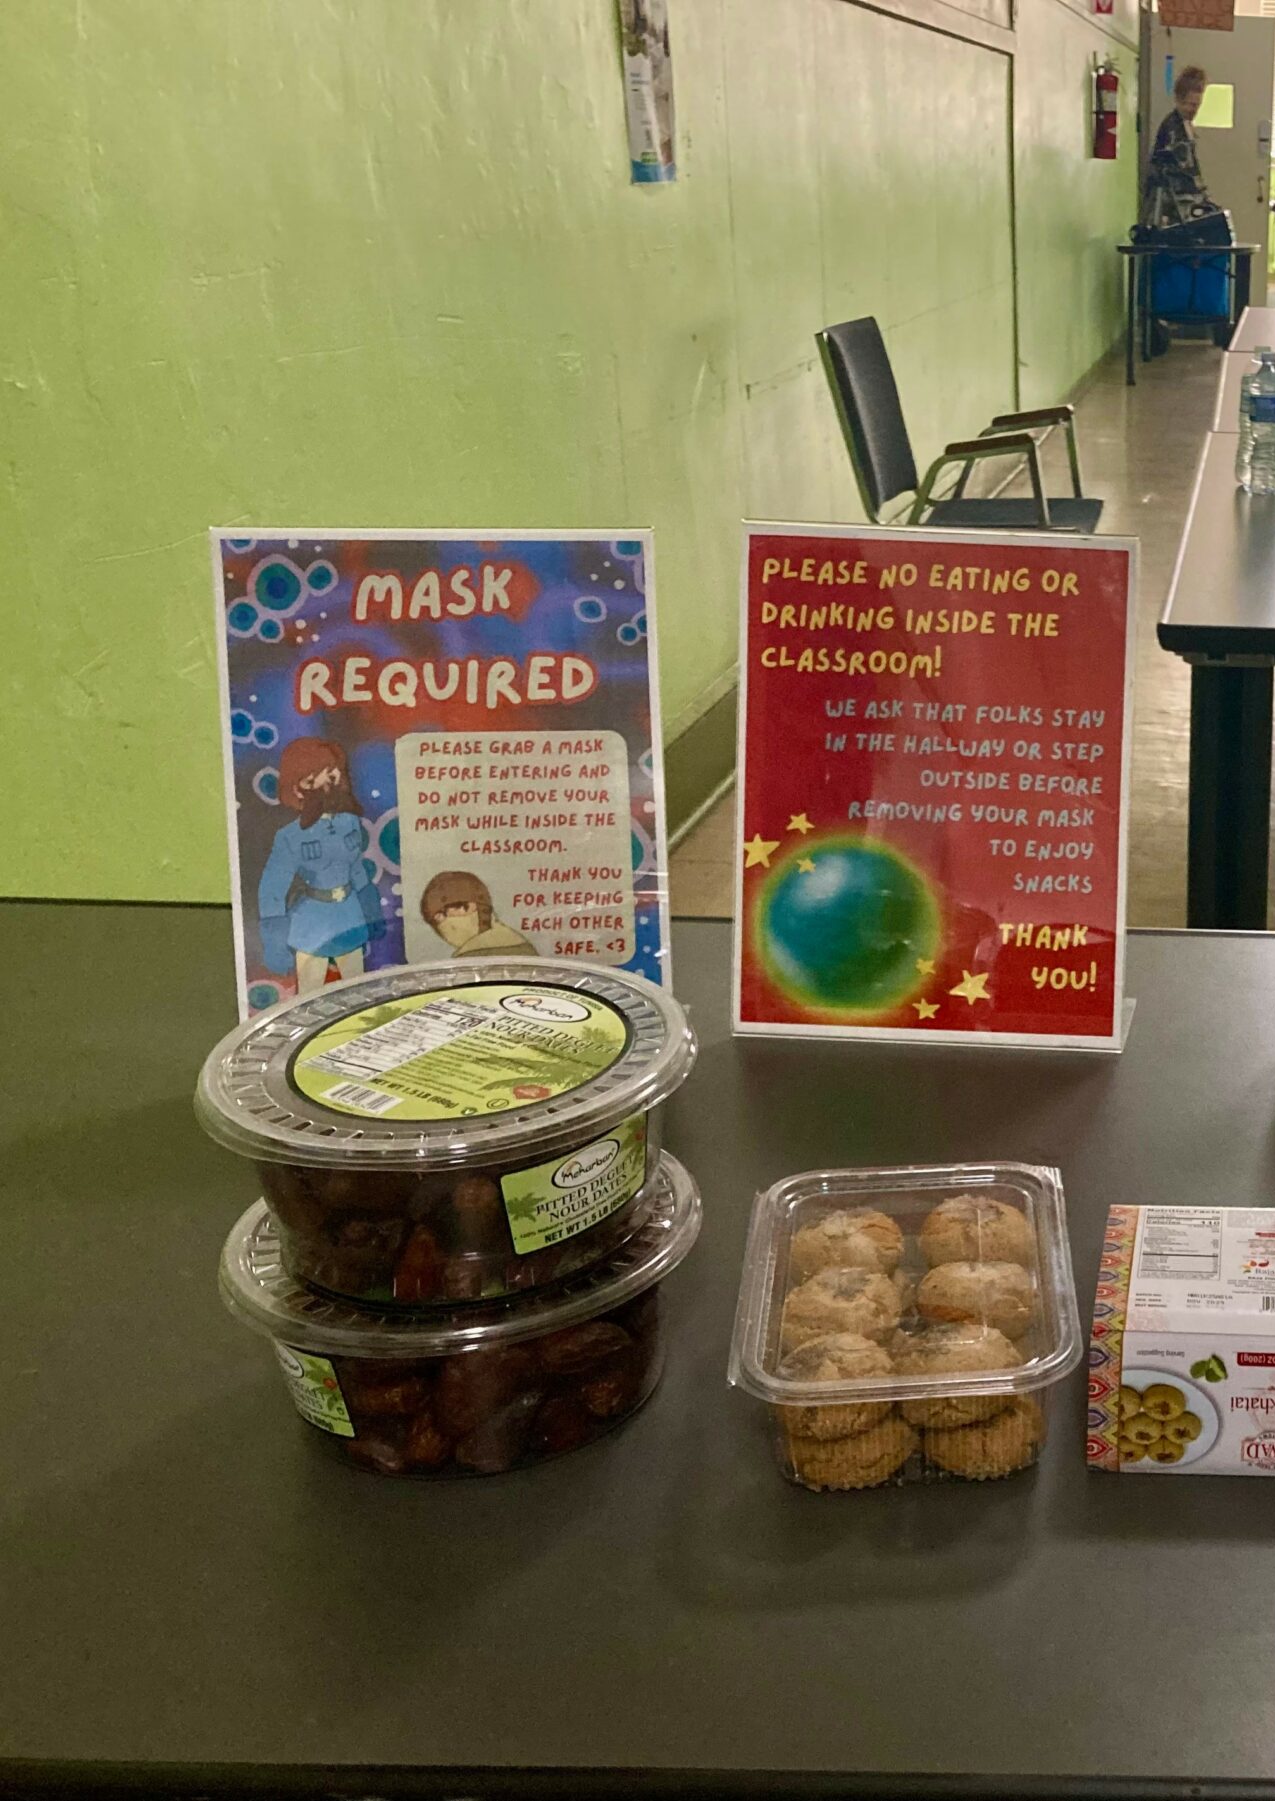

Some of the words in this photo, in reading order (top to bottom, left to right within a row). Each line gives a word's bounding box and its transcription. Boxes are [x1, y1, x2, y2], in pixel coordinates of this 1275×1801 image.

[762, 557, 868, 585] PLEASE
[880, 562, 918, 590] NO
[929, 564, 1031, 595] EATING
[1042, 569, 1079, 597] OR
[356, 566, 513, 621] MASK
[762, 602, 894, 631] DRINKING
[905, 608, 995, 636] INSIDE
[1008, 612, 1060, 637] THE
[761, 646, 942, 678] CLASSROOM!
[300, 656, 594, 711] REQUIRED
[825, 700, 856, 717] WE
[865, 701, 903, 719] ASK
[913, 704, 966, 722] THAT
[976, 706, 1043, 726] FOLKS
[1052, 708, 1105, 728] STAY
[420, 740, 483, 756] PLEASE
[490, 740, 535, 756] GRAB
[542, 741, 553, 755] A
[559, 739, 604, 755] MASK
[825, 732, 845, 751] IN
[856, 733, 894, 752] THE
[903, 735, 1003, 758] HALLWAY
[1014, 742, 1042, 760] OR
[1051, 743, 1103, 760] STEP
[415, 764, 482, 780] BEFORE
[489, 764, 571, 780] ENTERING
[579, 764, 611, 779] AND
[920, 770, 1009, 790] OUTSIDE
[1019, 775, 1103, 795] BEFORE
[418, 790, 440, 805] DO
[449, 790, 480, 805] NOT
[488, 790, 558, 805] REMOVE
[564, 789, 610, 805] YOUR
[415, 815, 459, 832] MASK
[467, 813, 519, 829] WHILE
[525, 812, 578, 828] INSIDE
[584, 811, 616, 827] THE
[848, 802, 962, 823] REMOVING
[971, 807, 1028, 826] YOUR
[1037, 809, 1094, 827] MASK
[460, 839, 568, 855] CLASSROOM.
[990, 840, 1016, 857] TO
[1025, 841, 1093, 860] ENJOY
[528, 867, 582, 882] THANK
[586, 866, 622, 881] YOU
[1013, 874, 1092, 894] SNACKS
[513, 893, 545, 907] FOR
[553, 891, 624, 906] KEEPING
[521, 916, 563, 931] EACH
[570, 916, 625, 929] OTHER
[554, 940, 600, 956] SAFE.
[606, 939, 625, 953] <3
[999, 923, 1088, 952] THANK
[1031, 962, 1097, 991] YOU!
[498, 1015, 554, 1034] PITTED
[561, 1150, 614, 1183] Meharban
[535, 1187, 588, 1216] PITTED
[549, 1197, 589, 1222] NOUR
[592, 1173, 628, 1202] DATES
[544, 1229, 564, 1243] NET
[566, 1222, 581, 1236] WT
[583, 1214, 597, 1227] 1.5
[599, 1205, 609, 1219] LB
